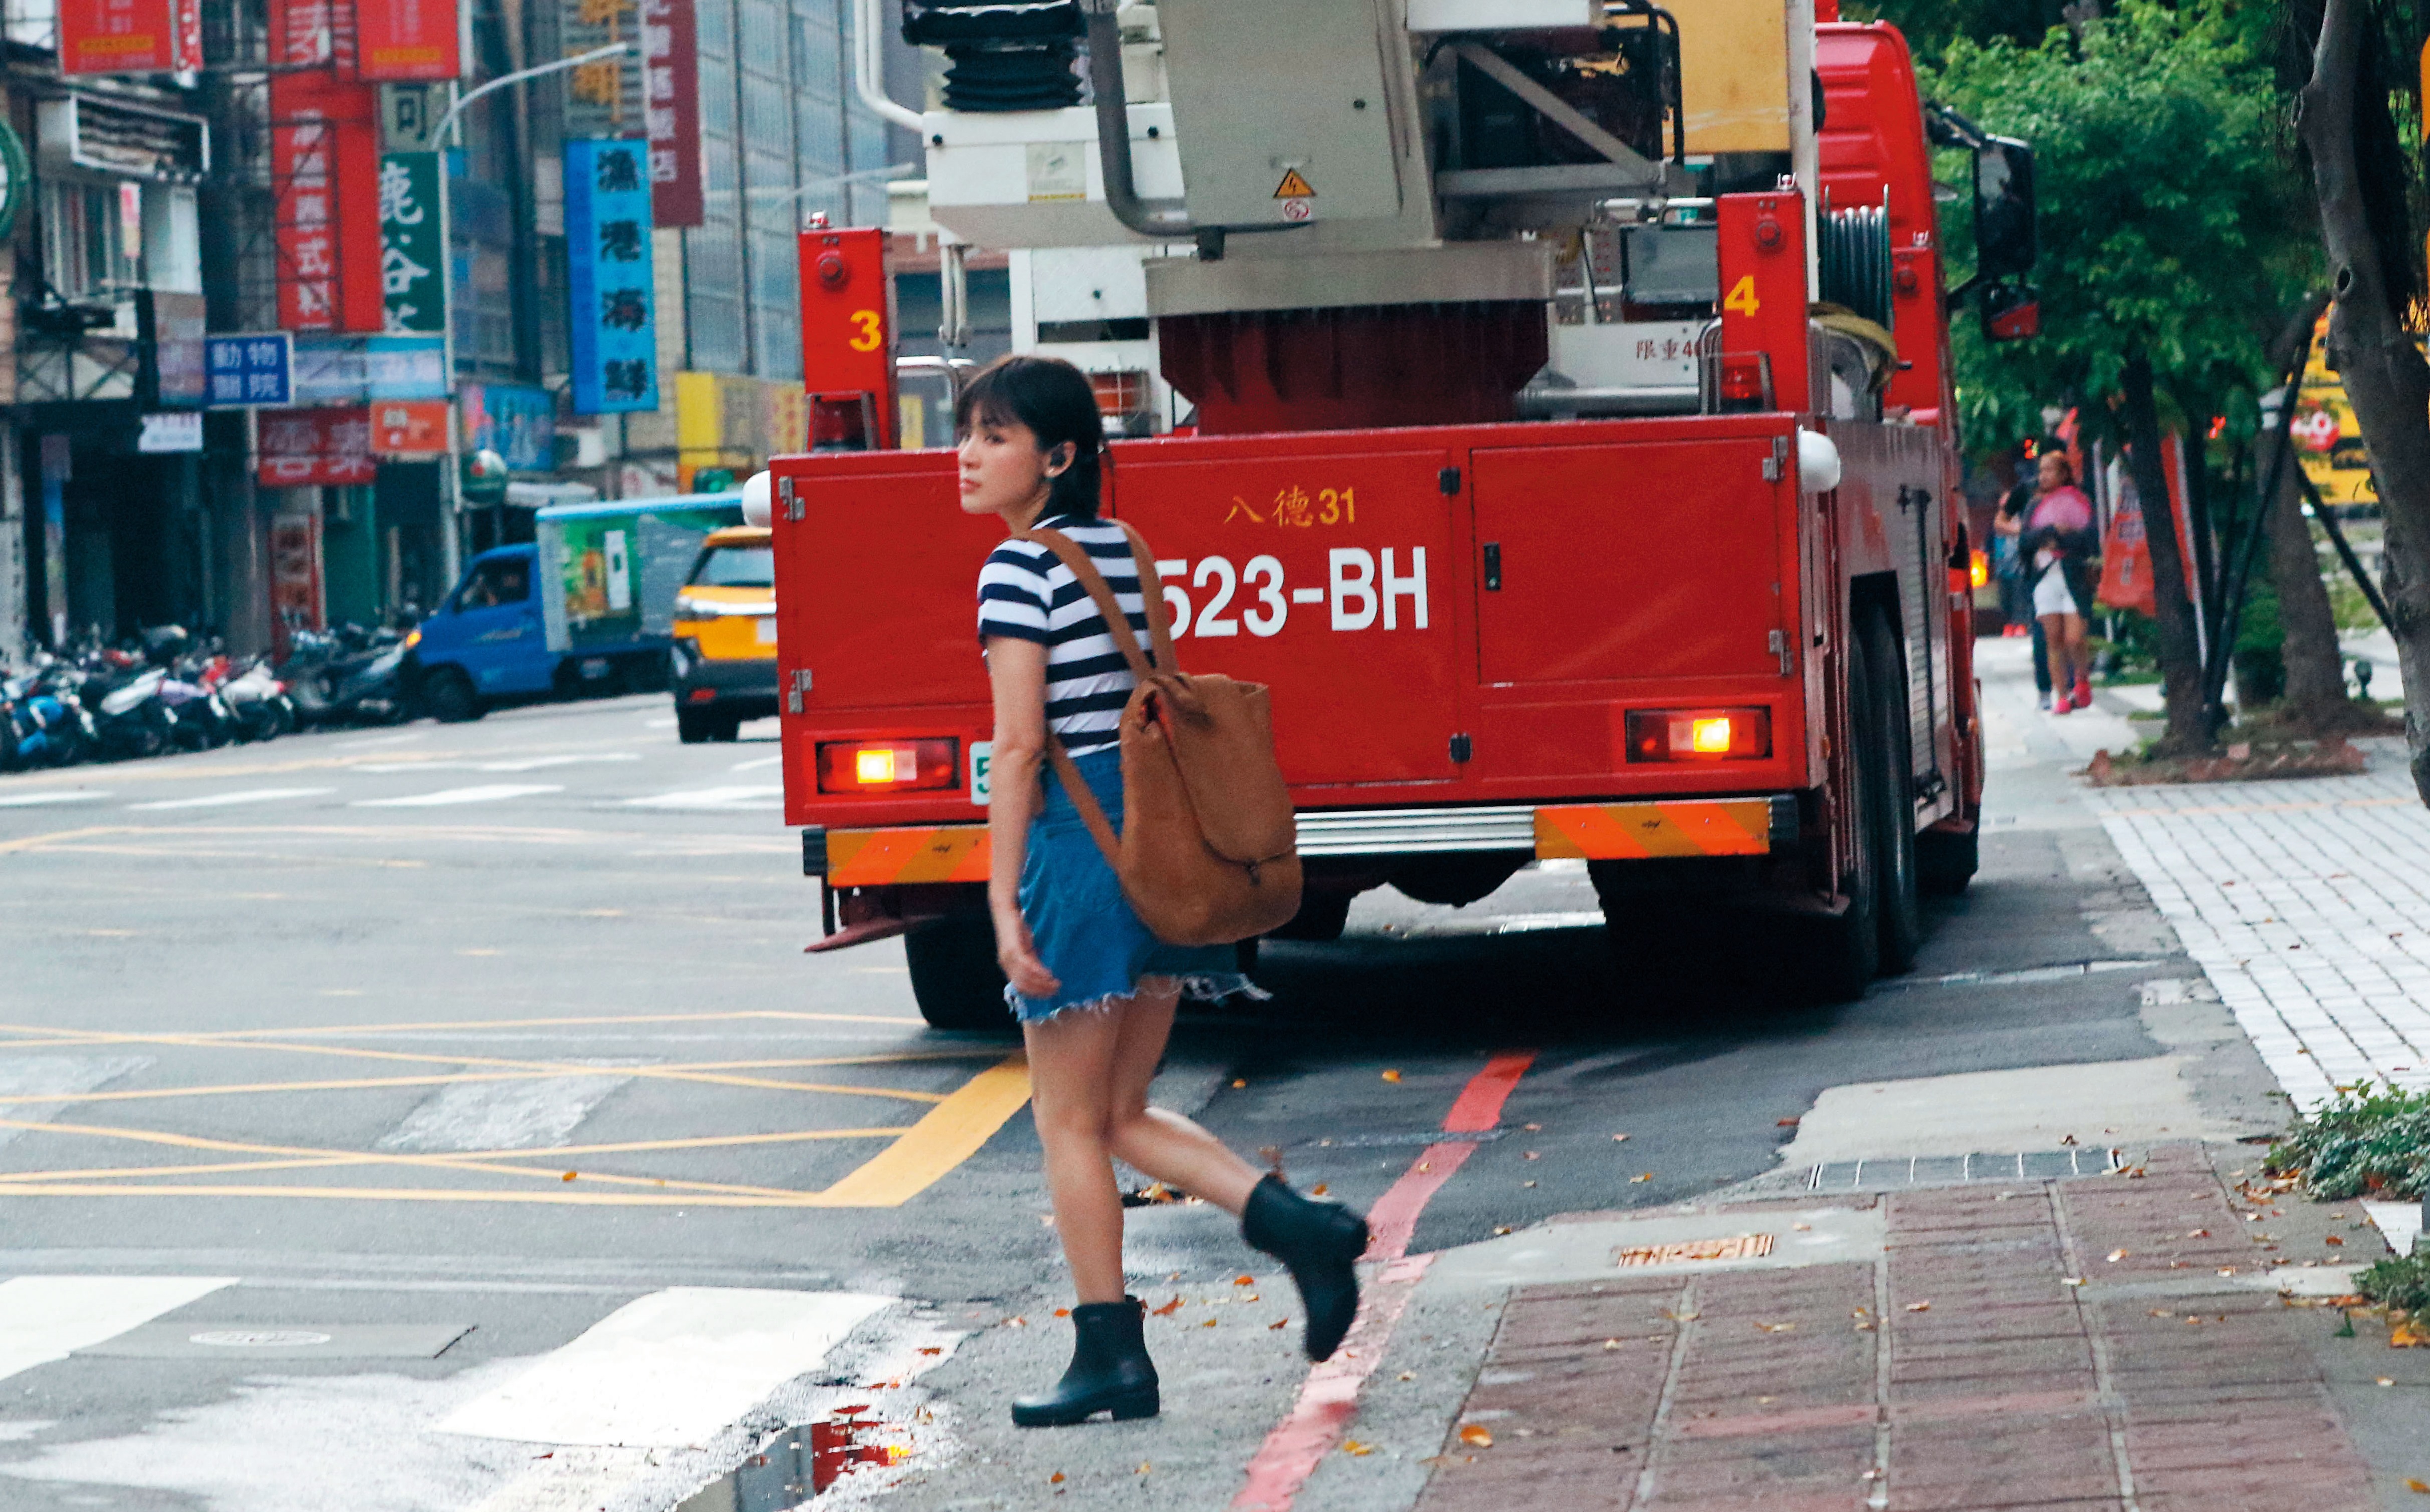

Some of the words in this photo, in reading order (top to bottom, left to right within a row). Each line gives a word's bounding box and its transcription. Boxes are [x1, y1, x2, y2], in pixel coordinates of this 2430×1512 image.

[598, 149, 647, 402] 漁港海鮮
[1724, 275, 1760, 317] 4
[850, 309, 882, 352] 3
[212, 341, 278, 369] 動物
[1223, 484, 1355, 528] 八德31
[1154, 546, 1429, 641] 523-BH
